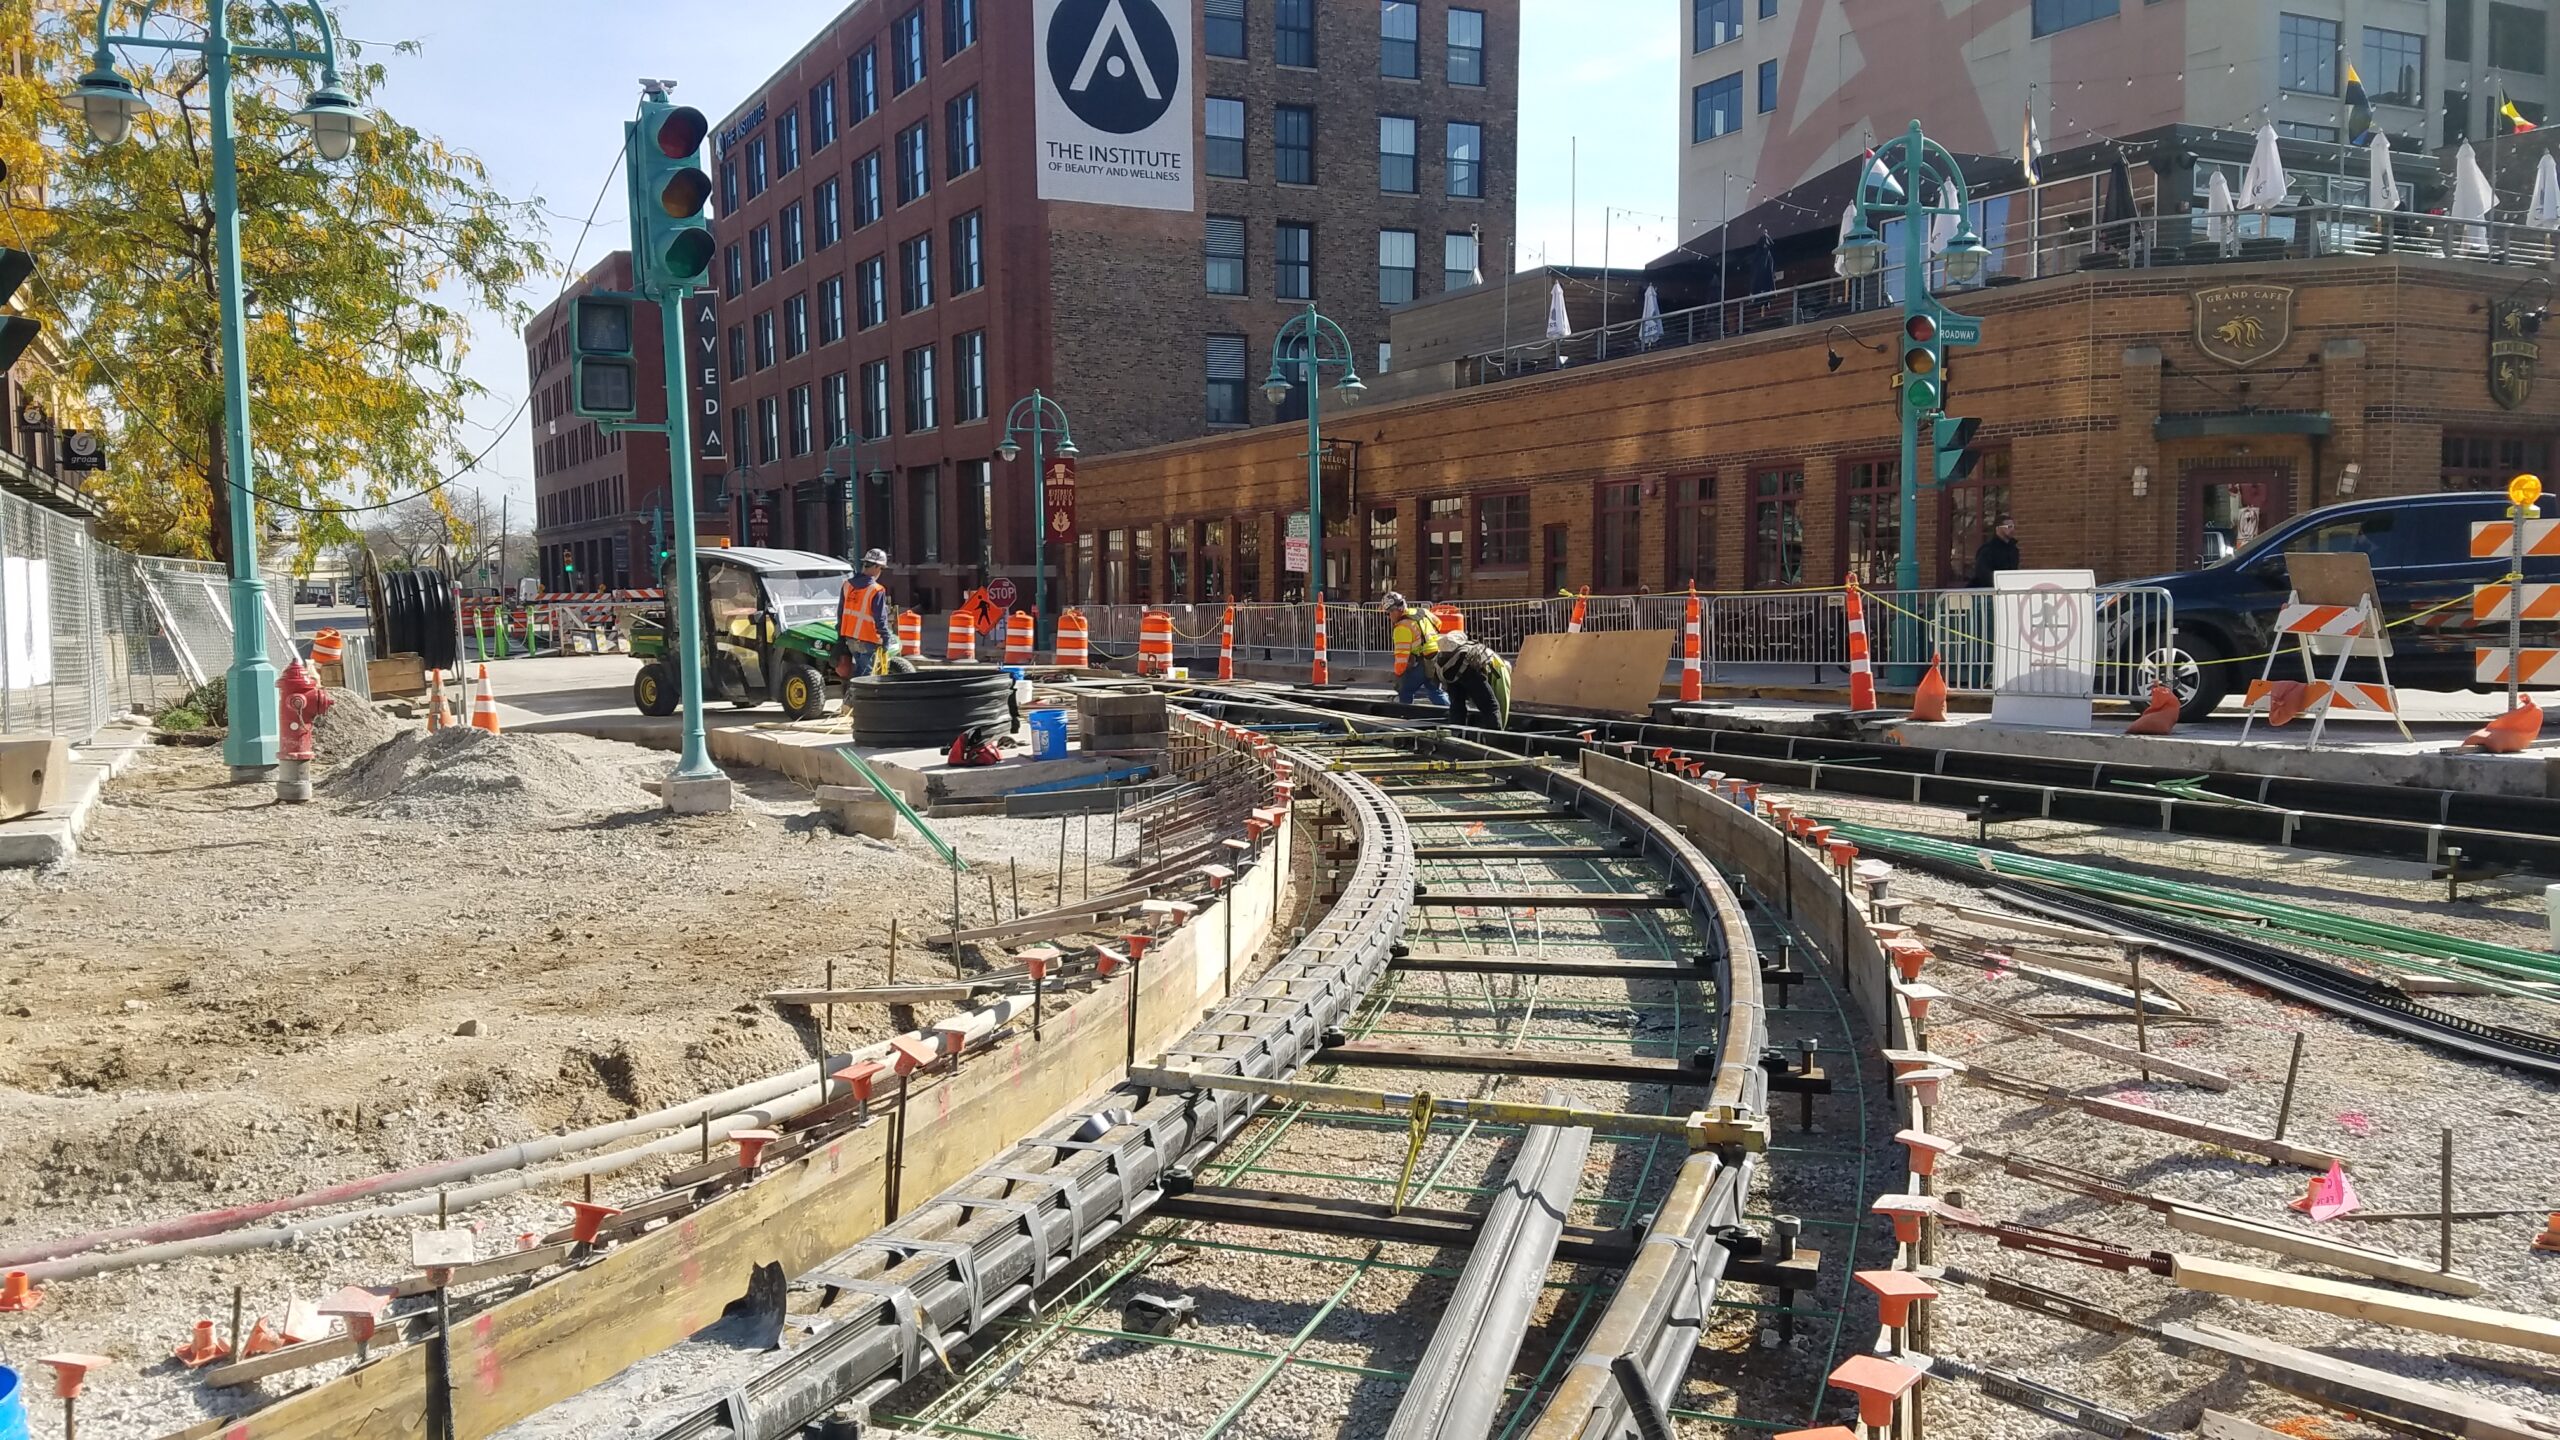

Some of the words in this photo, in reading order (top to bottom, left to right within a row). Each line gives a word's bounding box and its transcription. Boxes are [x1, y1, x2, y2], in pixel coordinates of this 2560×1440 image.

[724, 127, 736, 149] THE
[735, 102, 765, 138] INSTITUTE
[1046, 141, 1083, 160] THE
[1089, 145, 1181, 169] INSTITUTE
[1048, 161, 1062, 171] OF
[1065, 163, 1103, 175] BEAUTY
[1106, 167, 1128, 177] AND
[1129, 169, 1180, 182] WELLNESS
[2206, 291, 2248, 303] GRAND
[1940, 329, 1975, 340] ROADWAY
[700, 306, 720, 445] AVEDA
[1321, 455, 1347, 465] NELUX
[989, 587, 1014, 600] STOP
